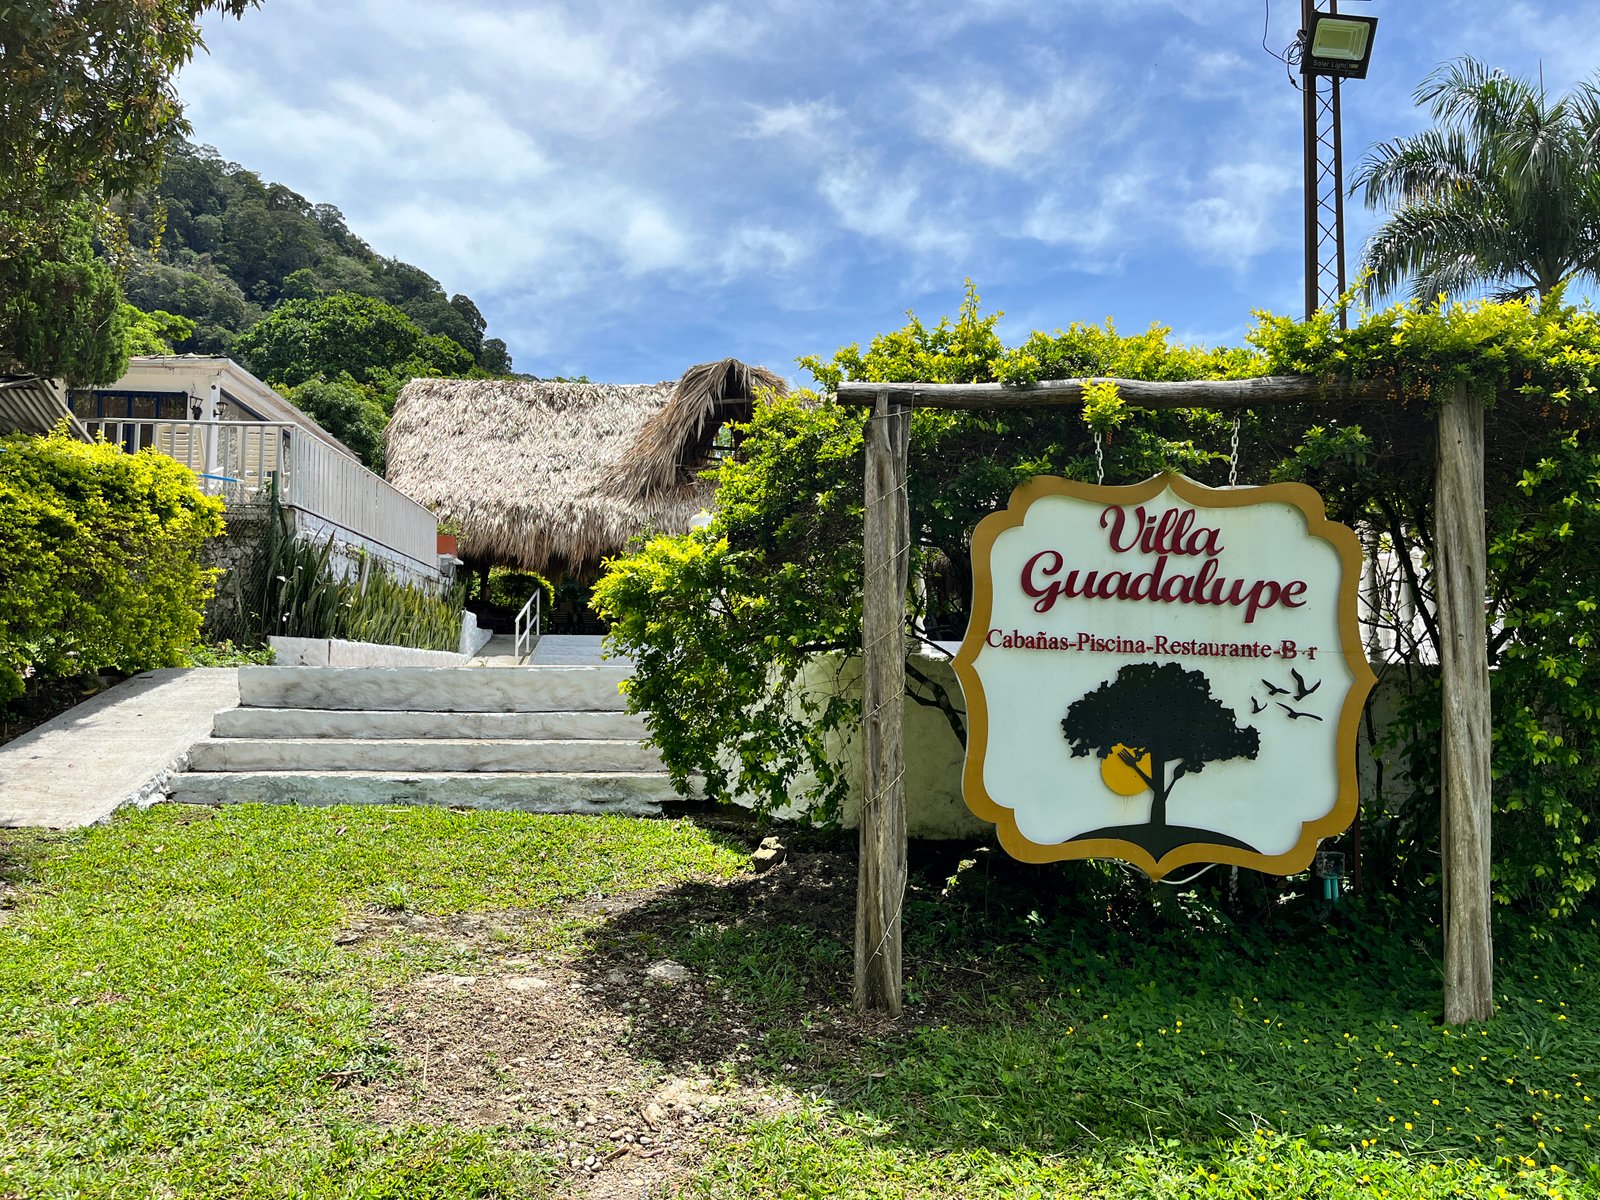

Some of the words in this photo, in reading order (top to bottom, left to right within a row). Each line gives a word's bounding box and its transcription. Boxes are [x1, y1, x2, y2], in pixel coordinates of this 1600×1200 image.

[1313, 59, 1329, 67] Solar
[1331, 62, 1347, 70] Light
[1100, 505, 1224, 556] Villa
[1020, 550, 1308, 624] Guadalupe
[986, 629, 1318, 661] Cabañas-Piscina-Restaurante-Br
